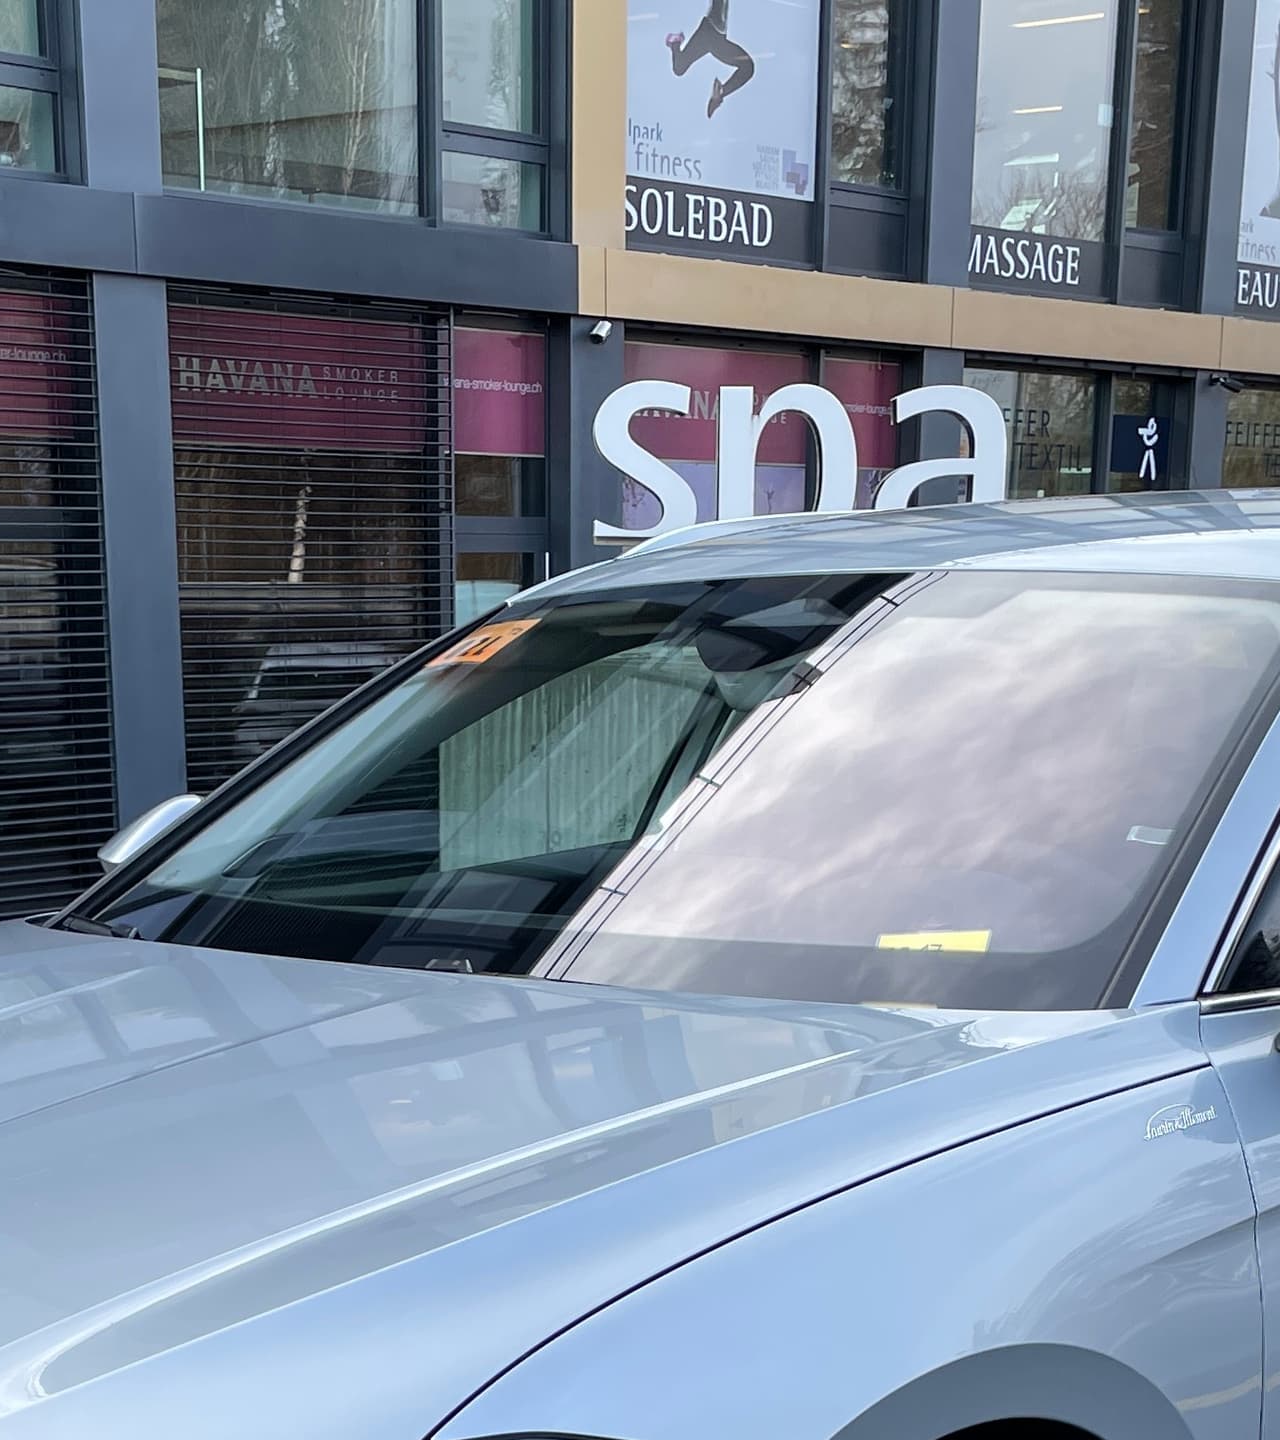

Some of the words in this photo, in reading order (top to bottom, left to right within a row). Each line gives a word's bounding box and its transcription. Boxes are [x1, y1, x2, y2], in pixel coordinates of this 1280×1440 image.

[635, 142, 702, 180] fitness
[624, 184, 773, 248] SOLEBAD
[178, 356, 318, 398] HAVANA
[323, 366, 399, 384] SMOKER
